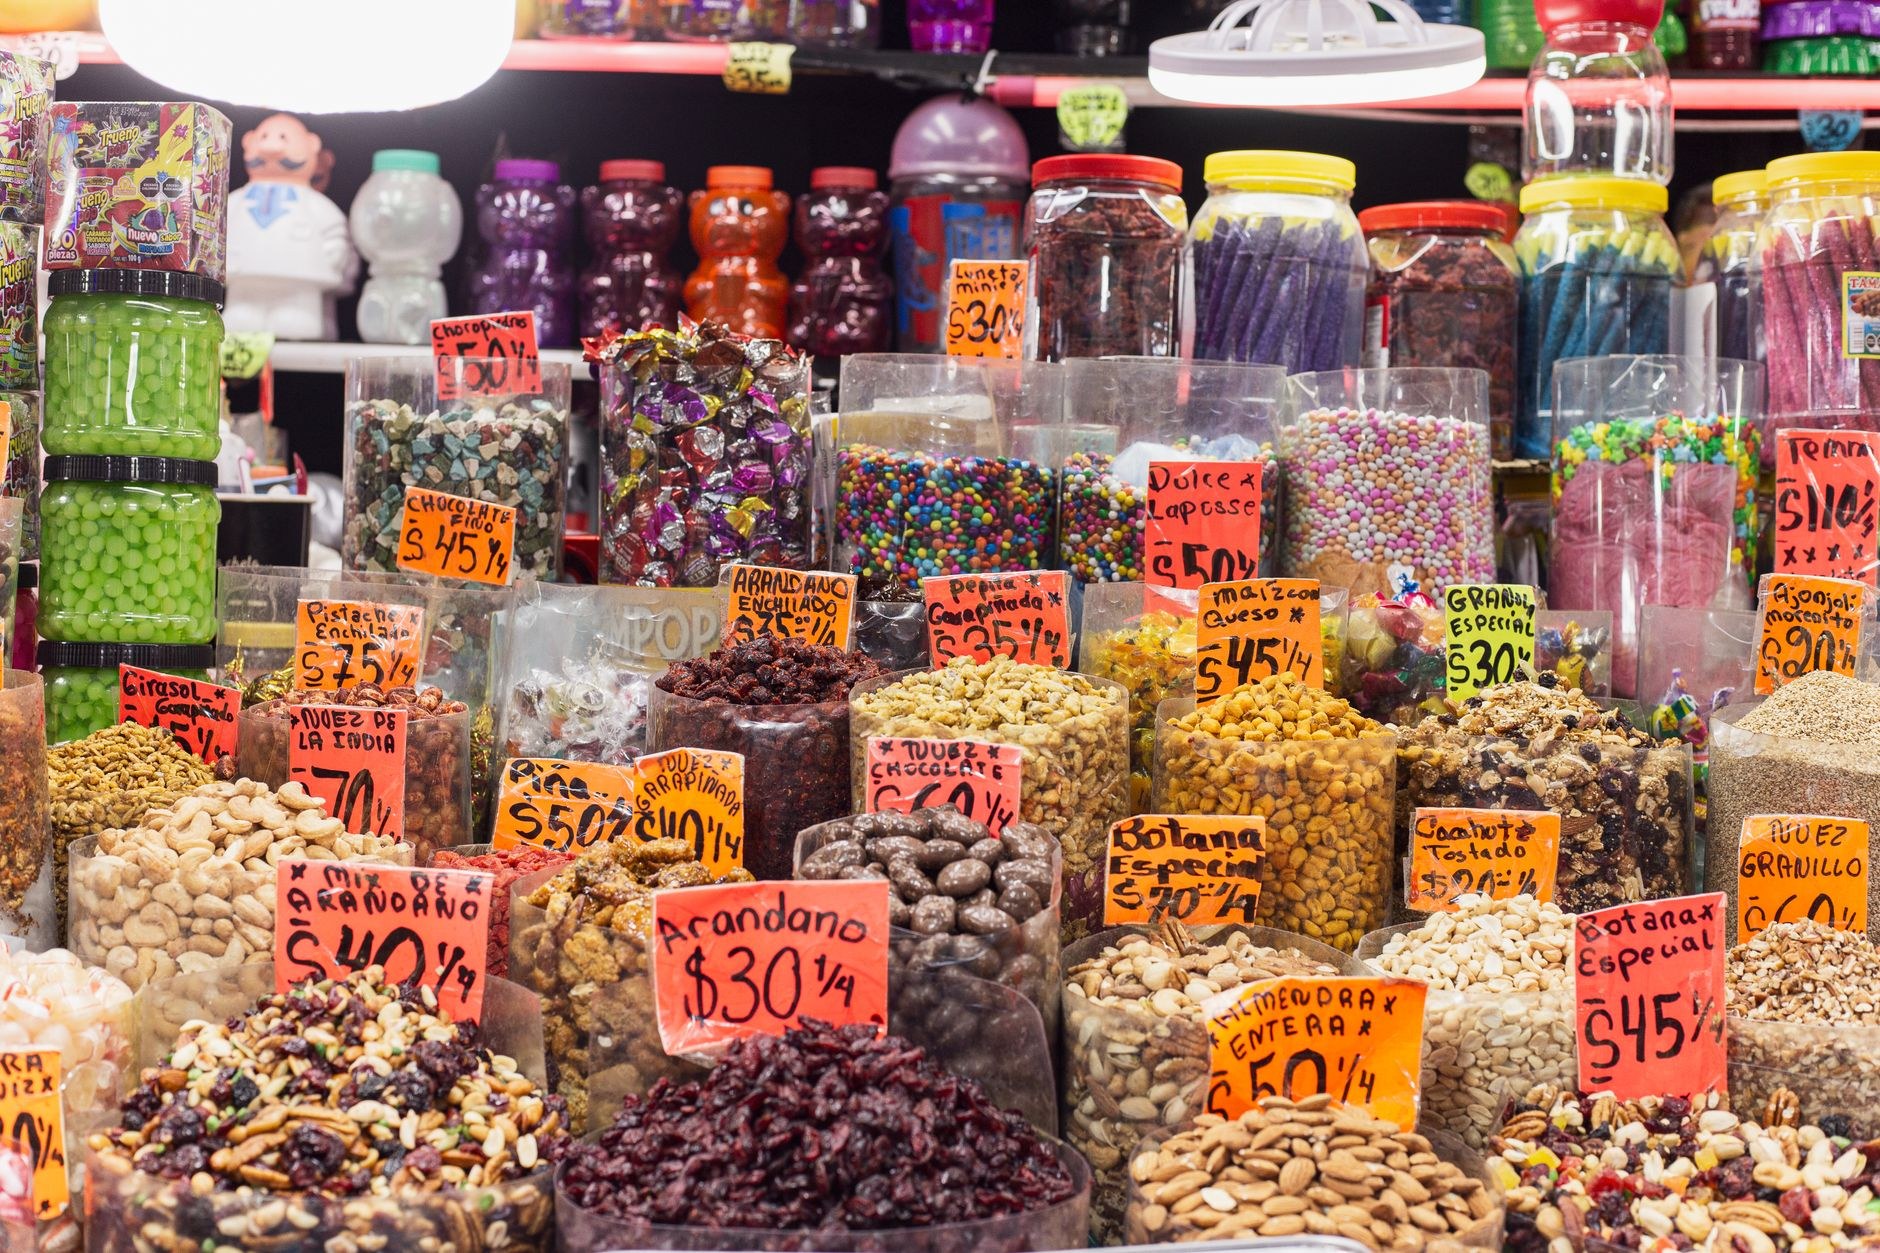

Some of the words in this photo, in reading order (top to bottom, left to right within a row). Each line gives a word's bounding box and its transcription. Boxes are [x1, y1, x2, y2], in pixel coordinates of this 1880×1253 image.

[100, 126, 139, 149] Trueno
[128, 229, 158, 242] nuevo
[49, 250, 76, 260] piezas
[949, 299, 1006, 345] $30
[407, 494, 511, 524] CHOCOLATE
[450, 514, 493, 533] FINO
[403, 518, 478, 574] $45
[733, 568, 849, 599] ARANDANO
[307, 601, 398, 624] Pistache
[1203, 607, 1279, 628] Queso
[1450, 610, 1535, 638] ESPECIAL
[301, 642, 385, 688] $75
[389, 649, 415, 685] 1/4
[1283, 637, 1313, 682] 1/4
[1448, 639, 1515, 691] $30
[122, 670, 201, 700] Girasol
[300, 708, 364, 730] NUEZ
[373, 711, 397, 731] DE
[299, 730, 324, 751] LA
[332, 731, 395, 753] INDIA
[871, 758, 1003, 781] CHOCOLATE
[708, 815, 741, 863] 1/4
[1112, 817, 1265, 851] Botana
[1110, 851, 1266, 885] Especial
[1421, 842, 1527, 863] Tostado
[1740, 850, 1862, 879] GRANILLO
[287, 886, 479, 921] ARANDANO
[657, 890, 868, 955] Arandano
[1578, 929, 1714, 982] Especial
[684, 945, 802, 1028] $30
[814, 953, 855, 1008] 1/4
[1229, 1013, 1346, 1060] ENTERA
[1582, 991, 1686, 1083] $45
[1337, 1053, 1376, 1104] 1/4
